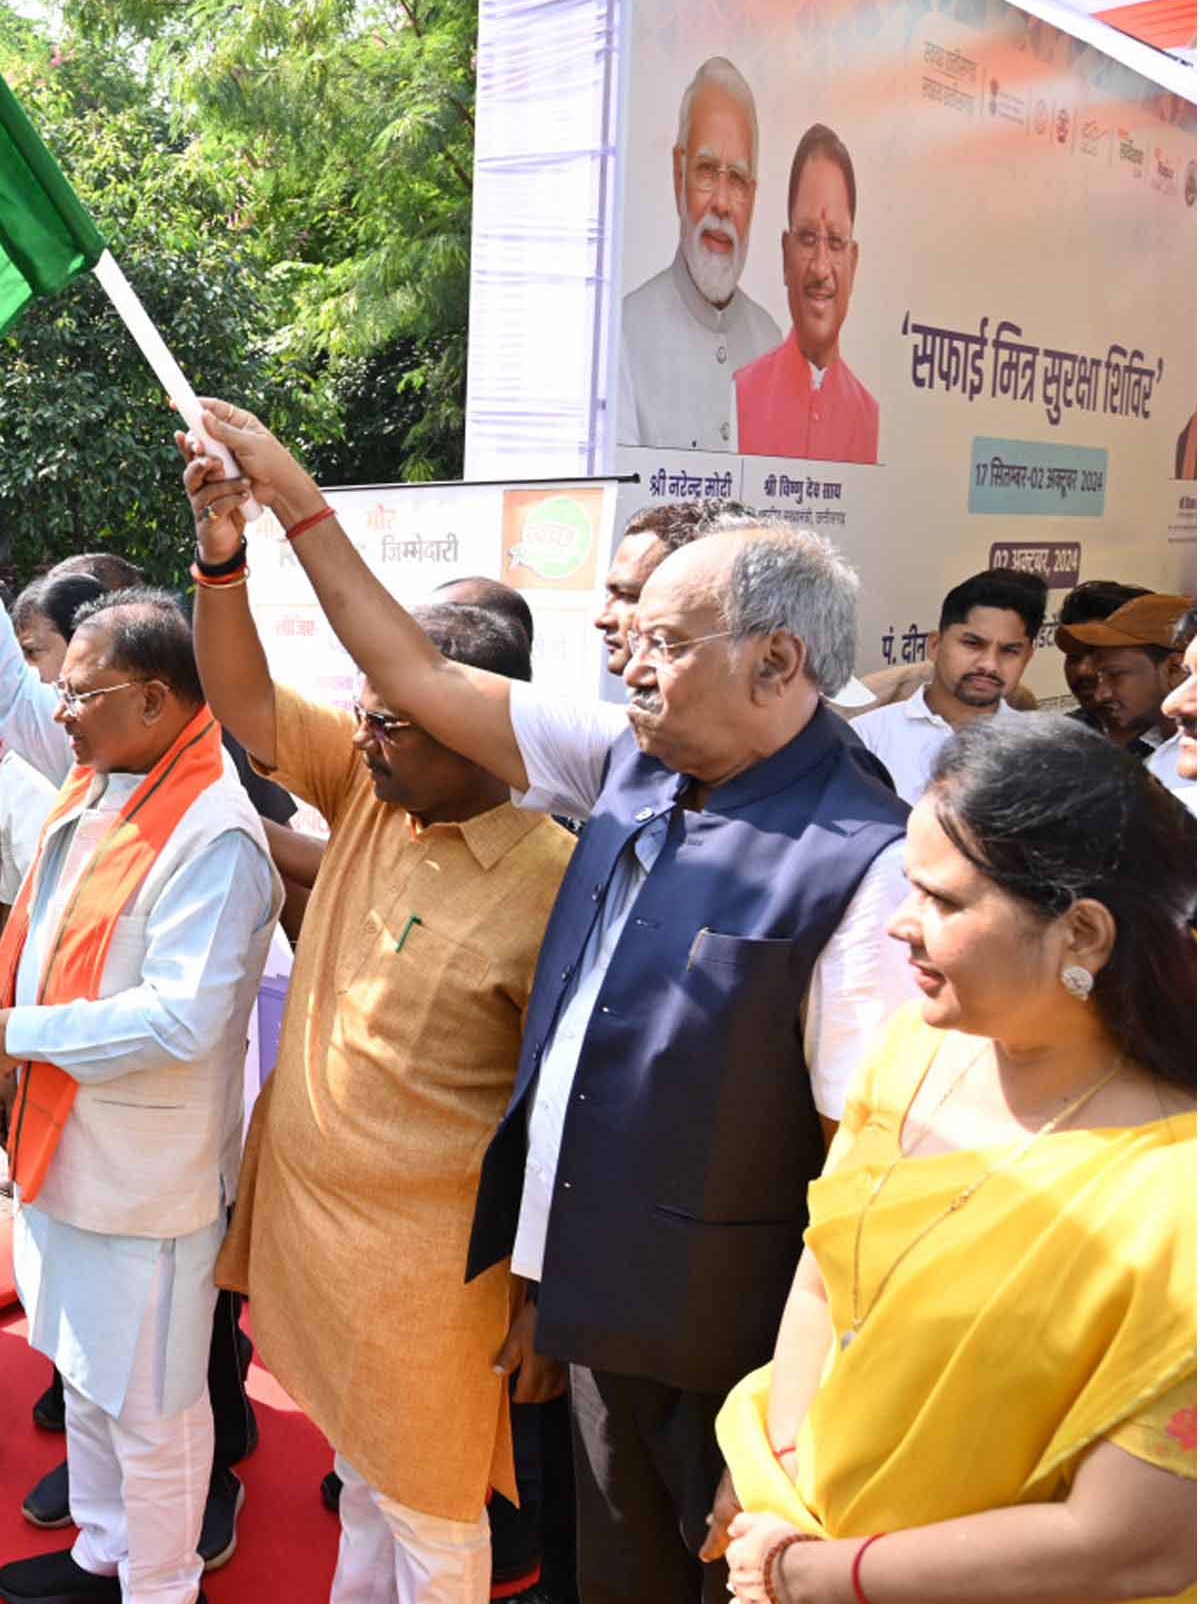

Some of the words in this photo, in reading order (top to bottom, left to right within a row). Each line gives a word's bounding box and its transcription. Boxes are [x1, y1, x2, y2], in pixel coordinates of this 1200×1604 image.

[991, 320, 1040, 403] मित्र
[1042, 348, 1103, 426] सुरक्षा
[650, 468, 666, 497] श्री
[668, 470, 703, 498] नरेन्द्र
[704, 471, 733, 498] मोदी
[779, 475, 803, 504] विष्णु
[822, 482, 842, 500] साय
[380, 533, 460, 563] जिम्मेदारी
[1053, 550, 1078, 574] 2024
